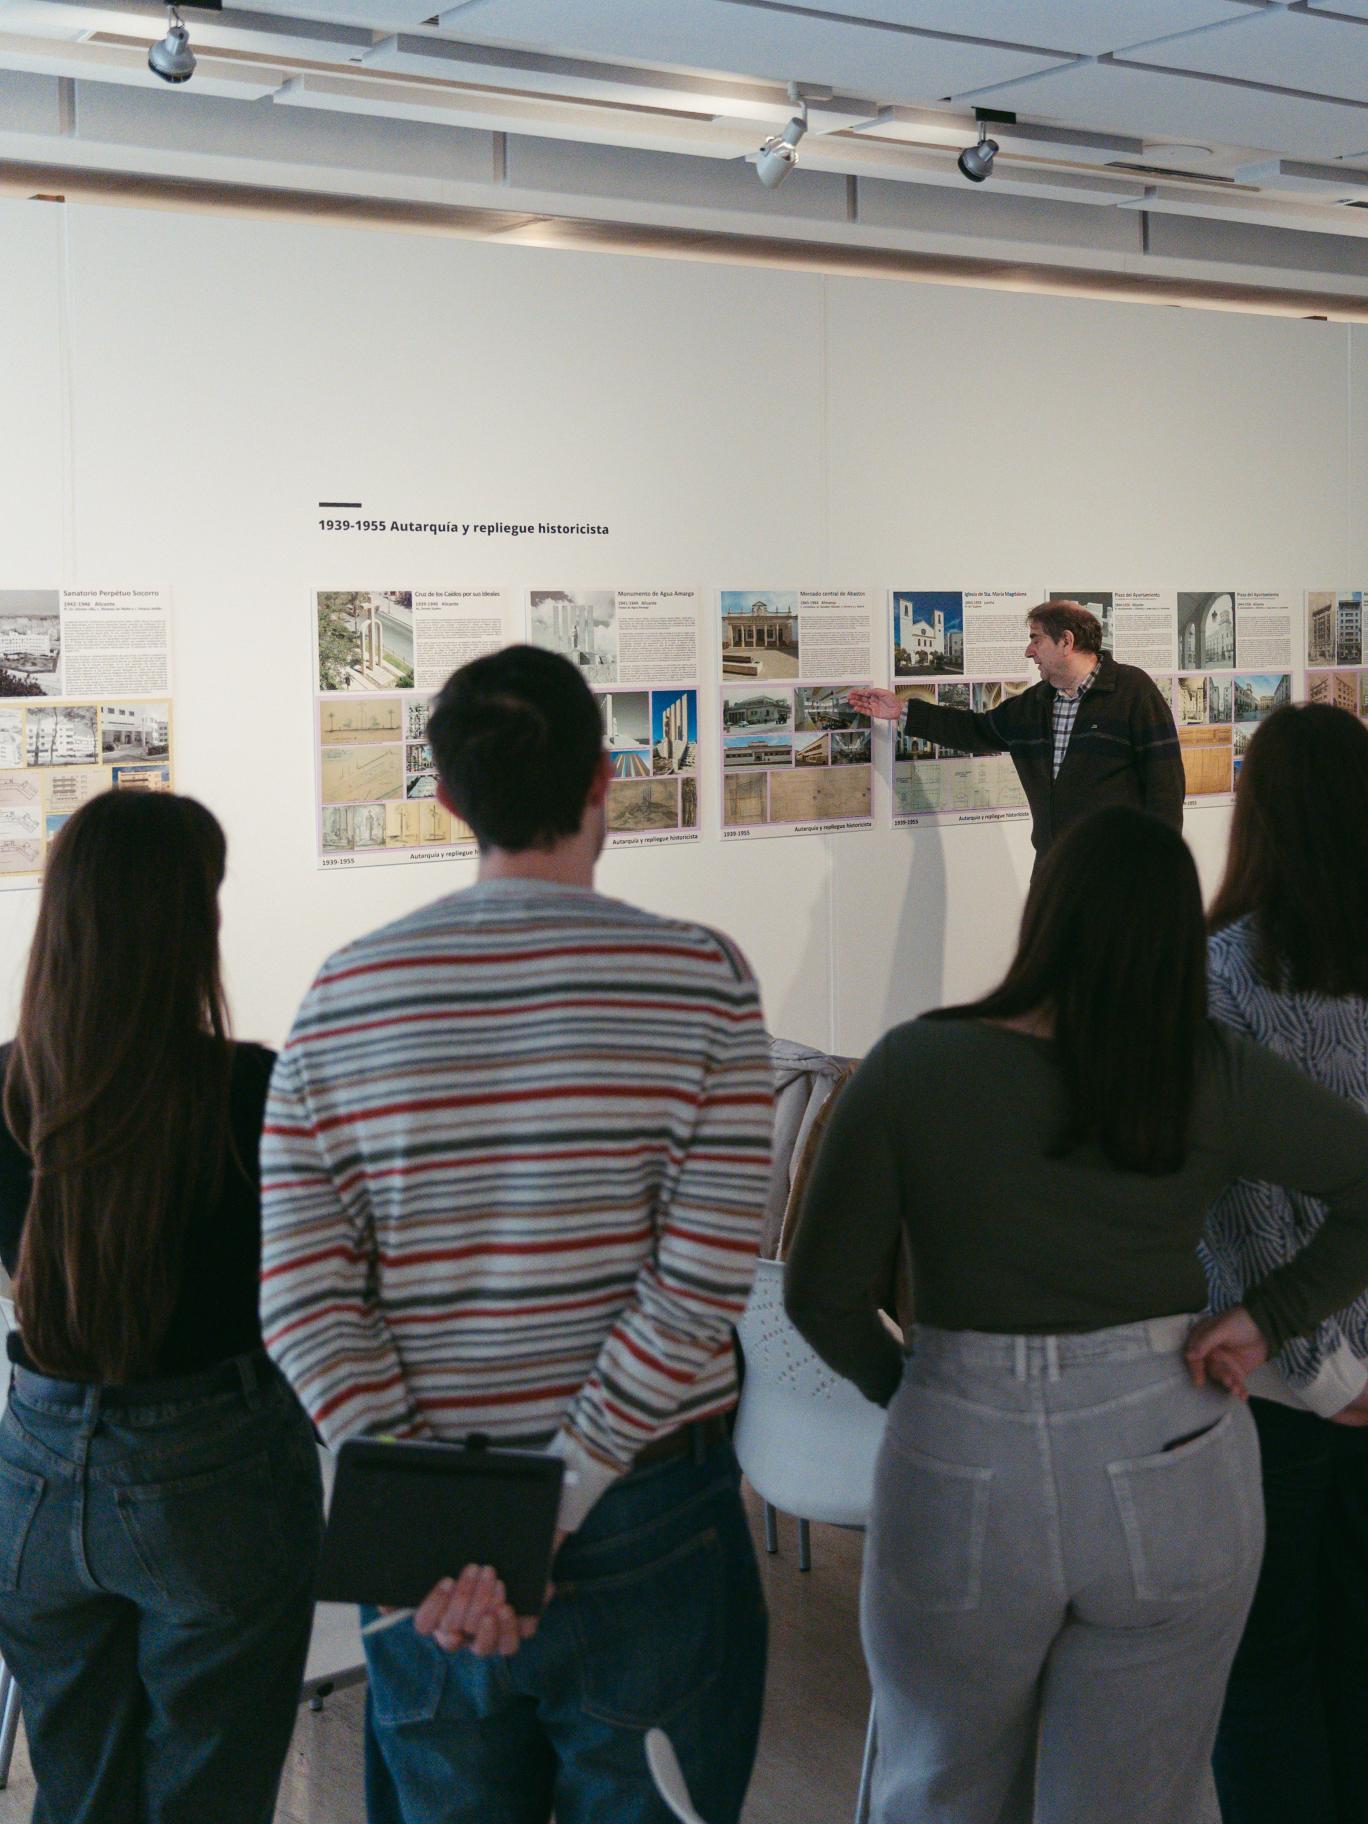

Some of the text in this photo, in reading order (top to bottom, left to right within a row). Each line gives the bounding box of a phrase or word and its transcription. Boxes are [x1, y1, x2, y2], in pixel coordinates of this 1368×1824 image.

[318, 520, 609, 536] 1939-1955 Autarquía y repliegue historicista
[322, 858, 355, 866] 1939-1955
